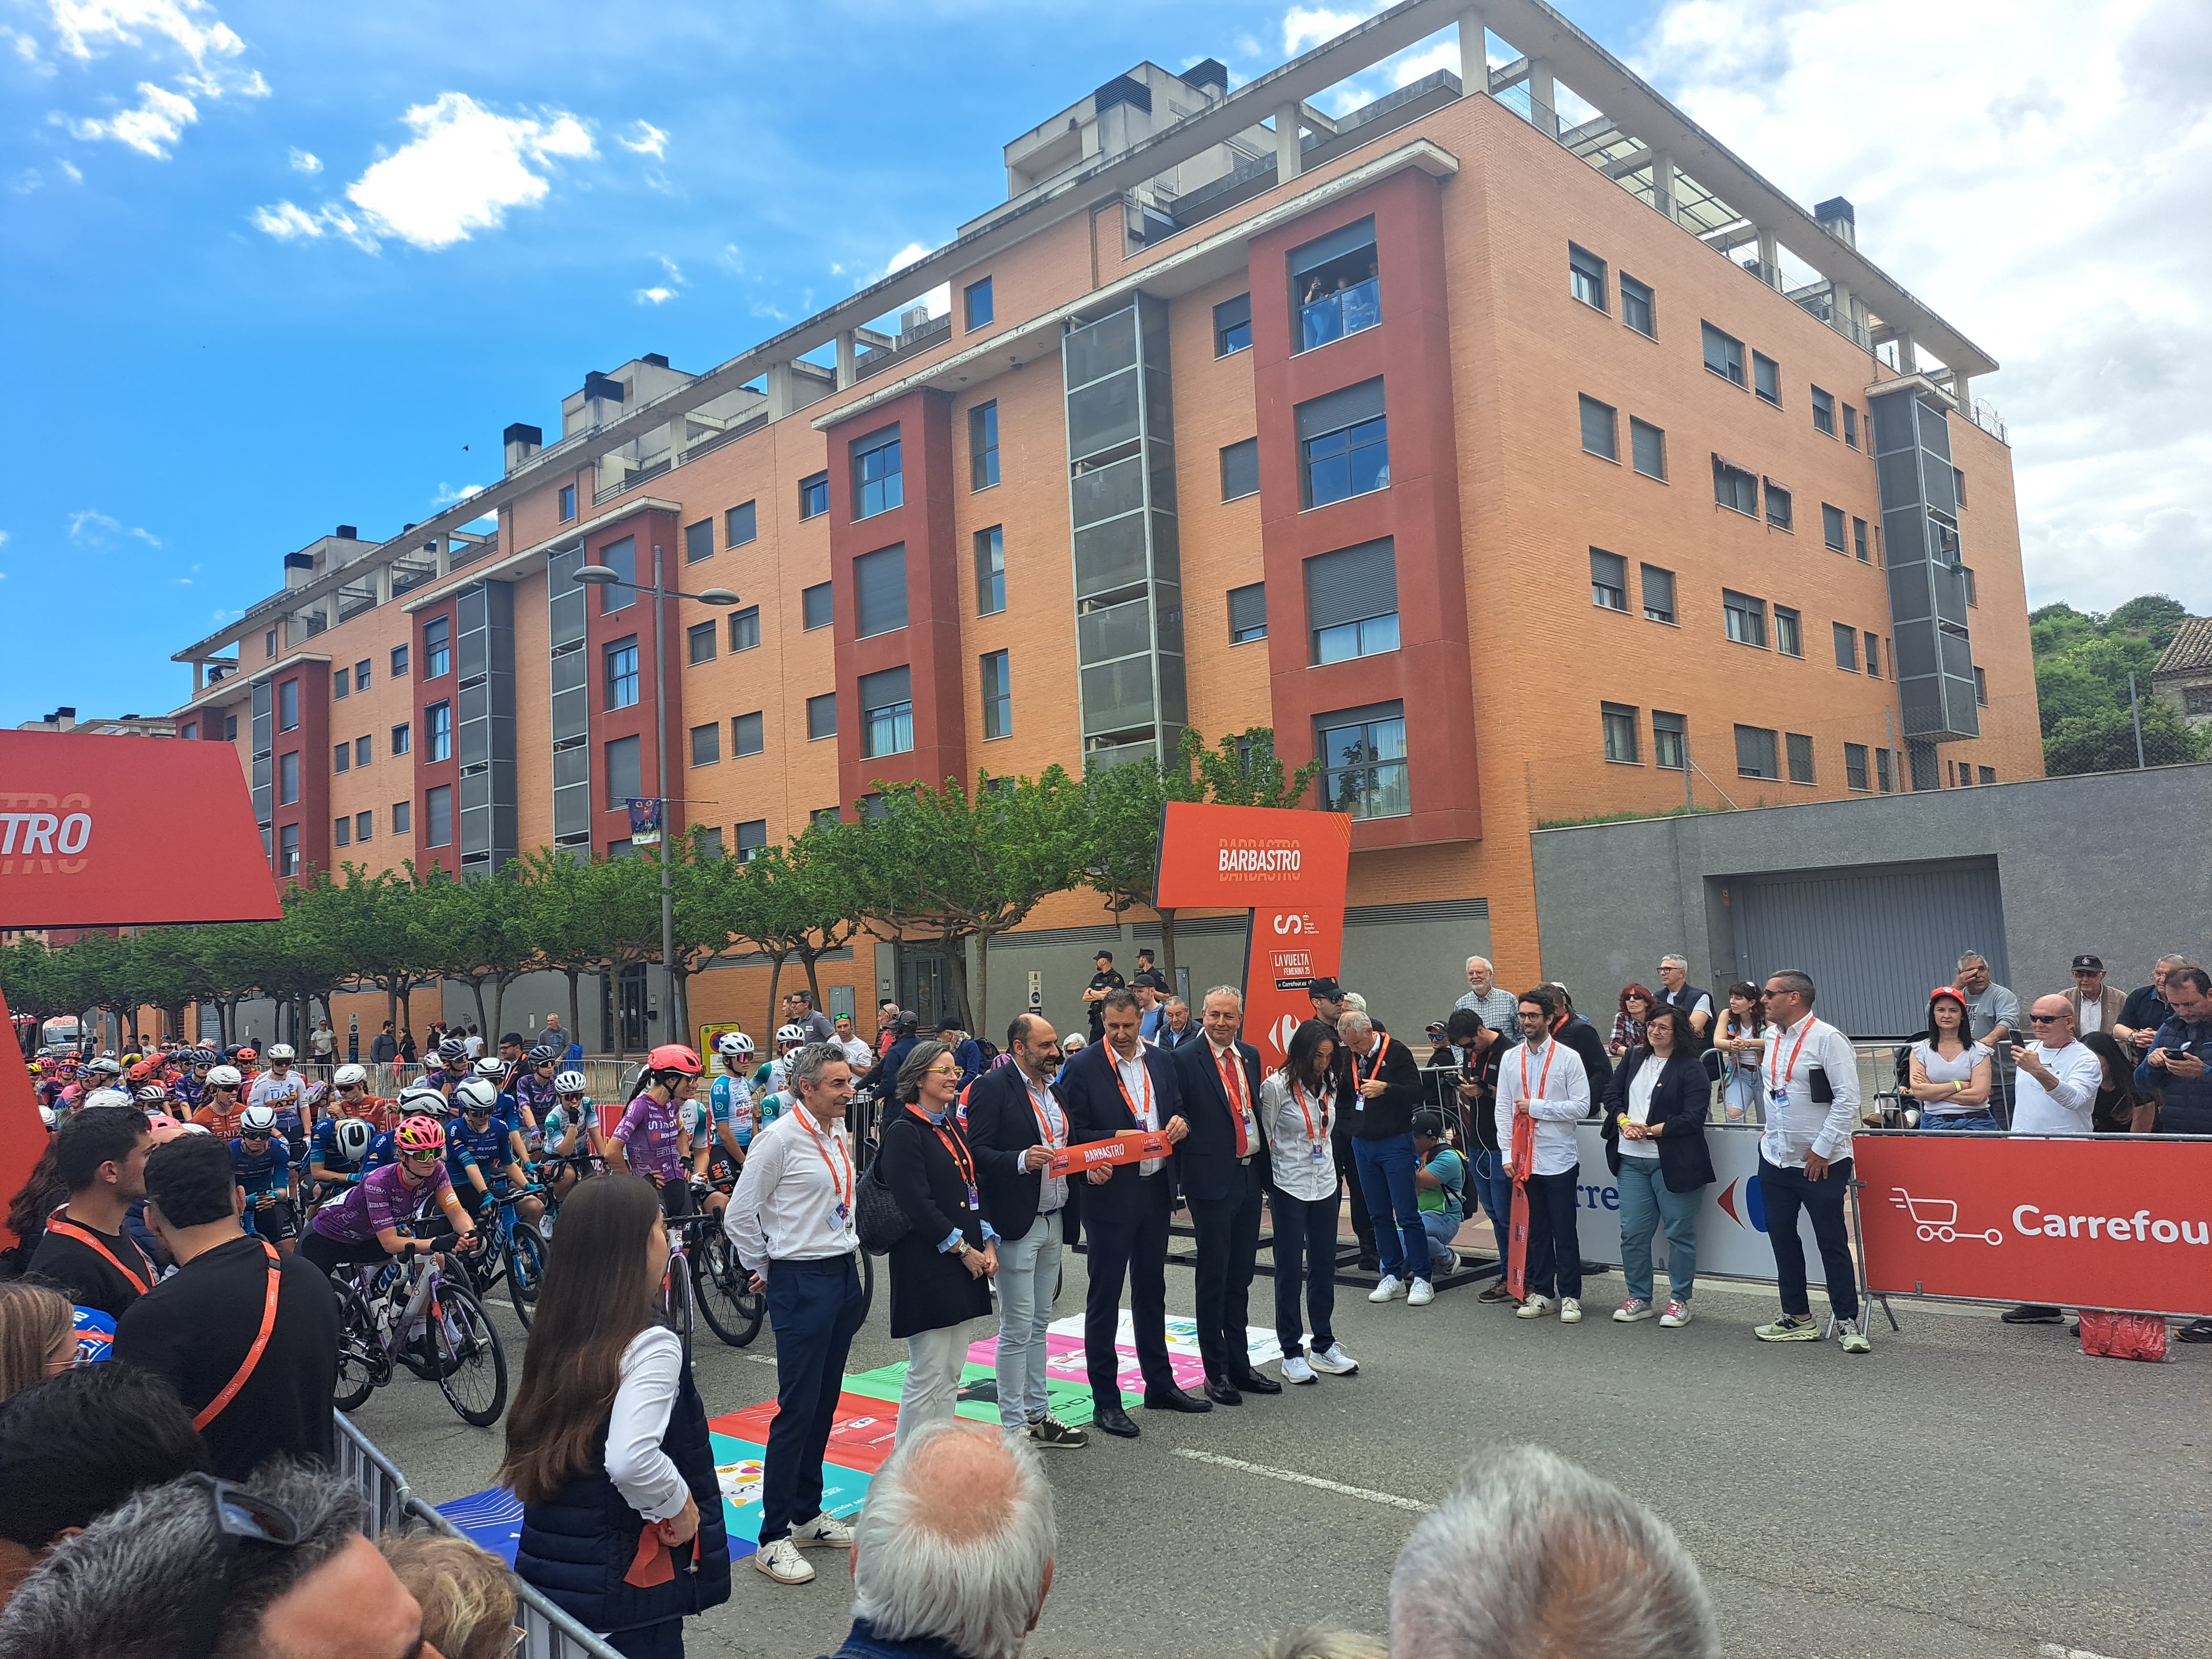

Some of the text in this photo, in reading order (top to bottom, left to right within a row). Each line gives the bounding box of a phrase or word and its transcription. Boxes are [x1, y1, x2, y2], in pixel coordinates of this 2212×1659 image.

[1218, 850, 1301, 871] BARBASTRO
[1274, 953, 1309, 967] LA VUELTA
[1283, 966, 1310, 976] FEMENINA 25
[271, 1089, 295, 1100] UAE
[1084, 1143, 1125, 1163] BARBASTRO
[2012, 1205, 2209, 1245] Carrefou
